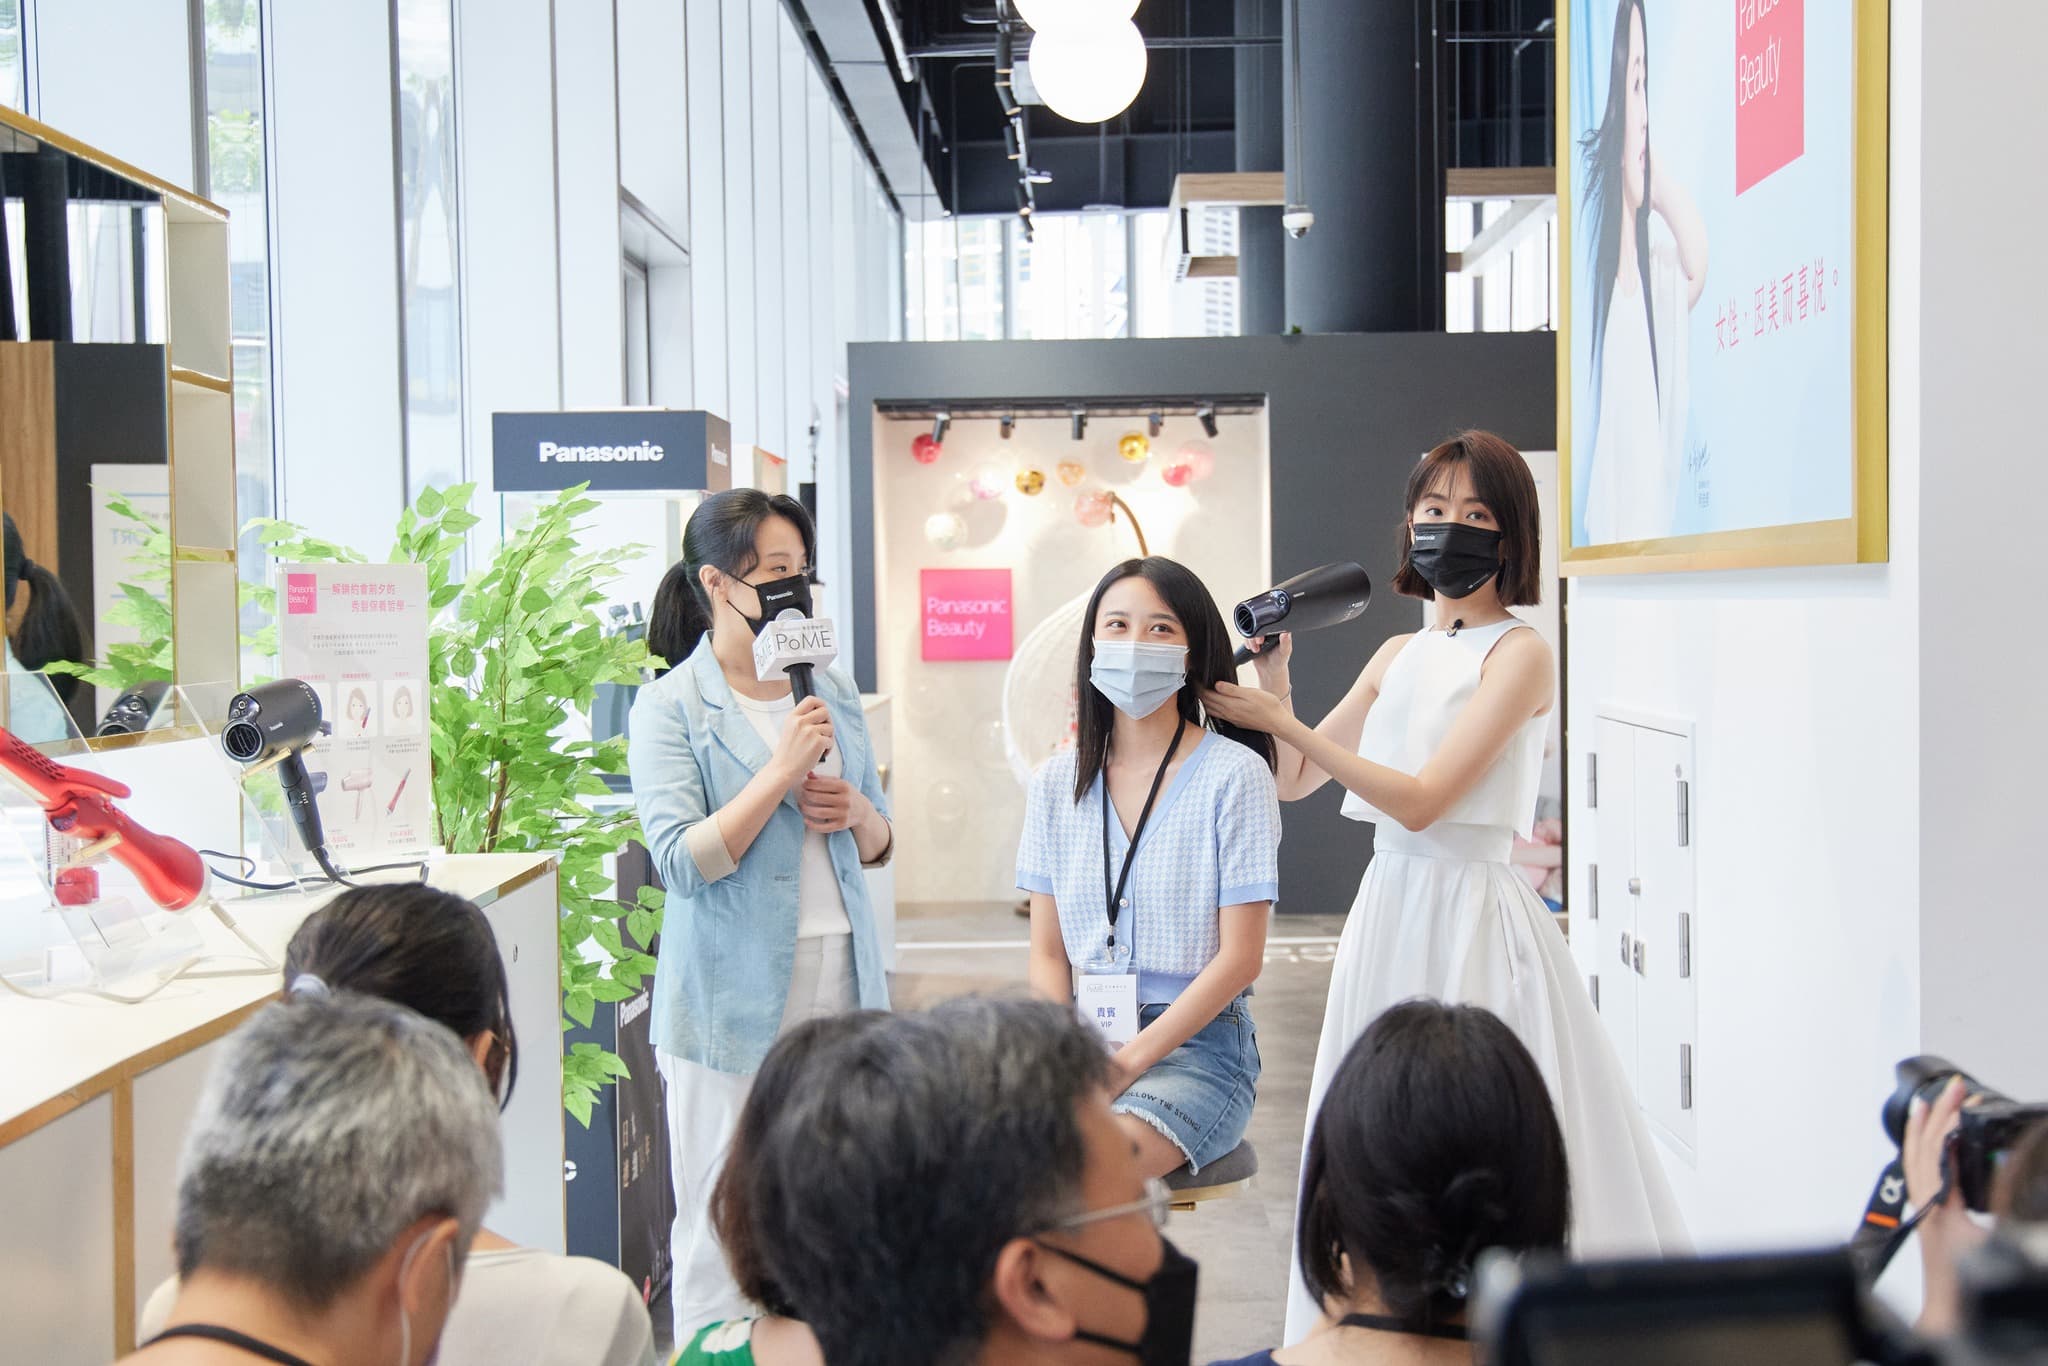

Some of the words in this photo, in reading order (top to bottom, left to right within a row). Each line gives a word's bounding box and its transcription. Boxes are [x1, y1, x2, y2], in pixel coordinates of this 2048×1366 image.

[1739, 36, 1782, 106] Beauty
[539, 441, 665, 462] Panasonic
[926, 597, 1008, 614] Panasonic
[926, 618, 987, 641] Beauty
[775, 630, 833, 652] PoME
[1096, 1006, 1117, 1018] 貴賓
[1100, 1020, 1113, 1029] VIP
